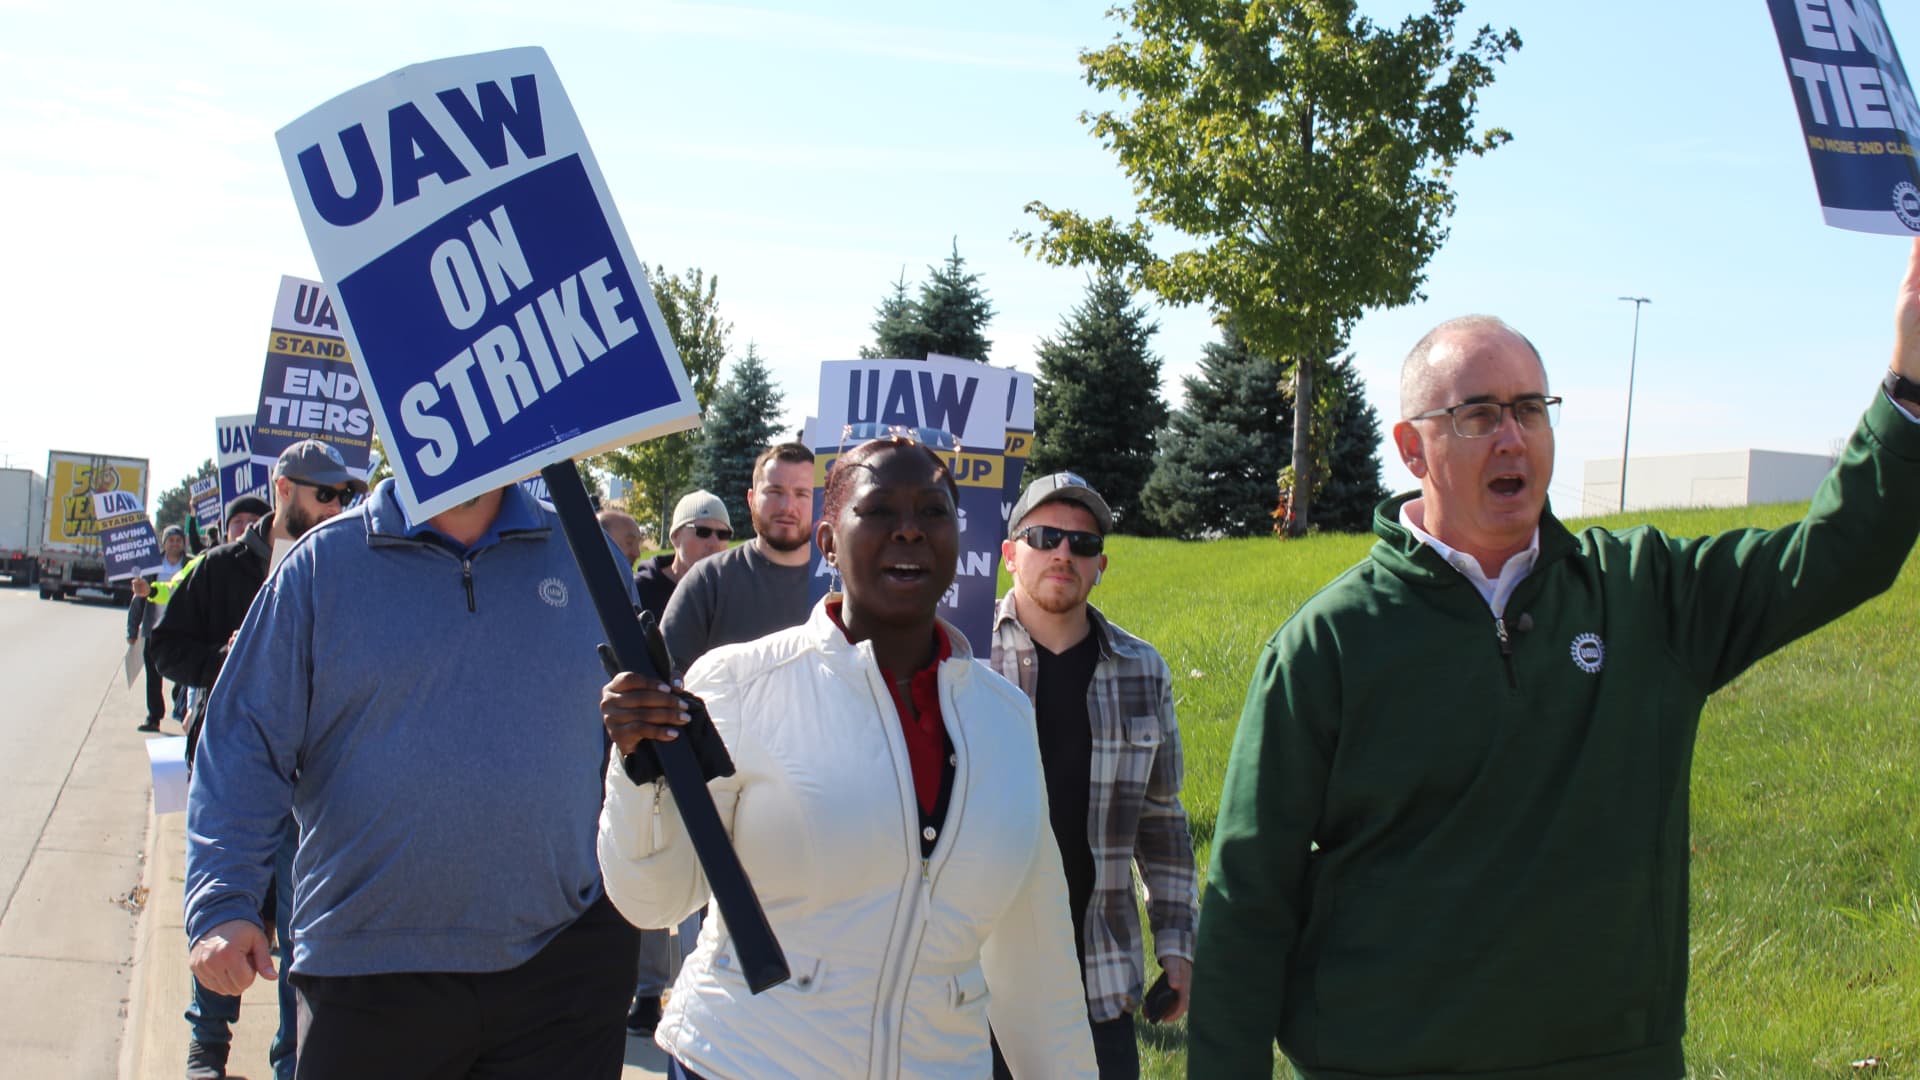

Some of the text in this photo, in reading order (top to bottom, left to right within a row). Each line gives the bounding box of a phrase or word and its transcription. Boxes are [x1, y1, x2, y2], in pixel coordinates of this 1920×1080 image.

[297, 74, 546, 227] UAW
[430, 204, 534, 331] ON
[294, 285, 339, 331] UA
[275, 336, 346, 358] STAND
[400, 256, 639, 476] STRIKE
[283, 366, 360, 401] END
[264, 396, 370, 436] TIERS
[847, 369, 979, 449] UAW
[235, 462, 252, 494] ON
[949, 458, 992, 481] UP
[103, 493, 137, 513] UAW
[105, 536, 156, 556] AMERICAN
[110, 526, 147, 542] SAVING
[115, 547, 151, 563] DREAM
